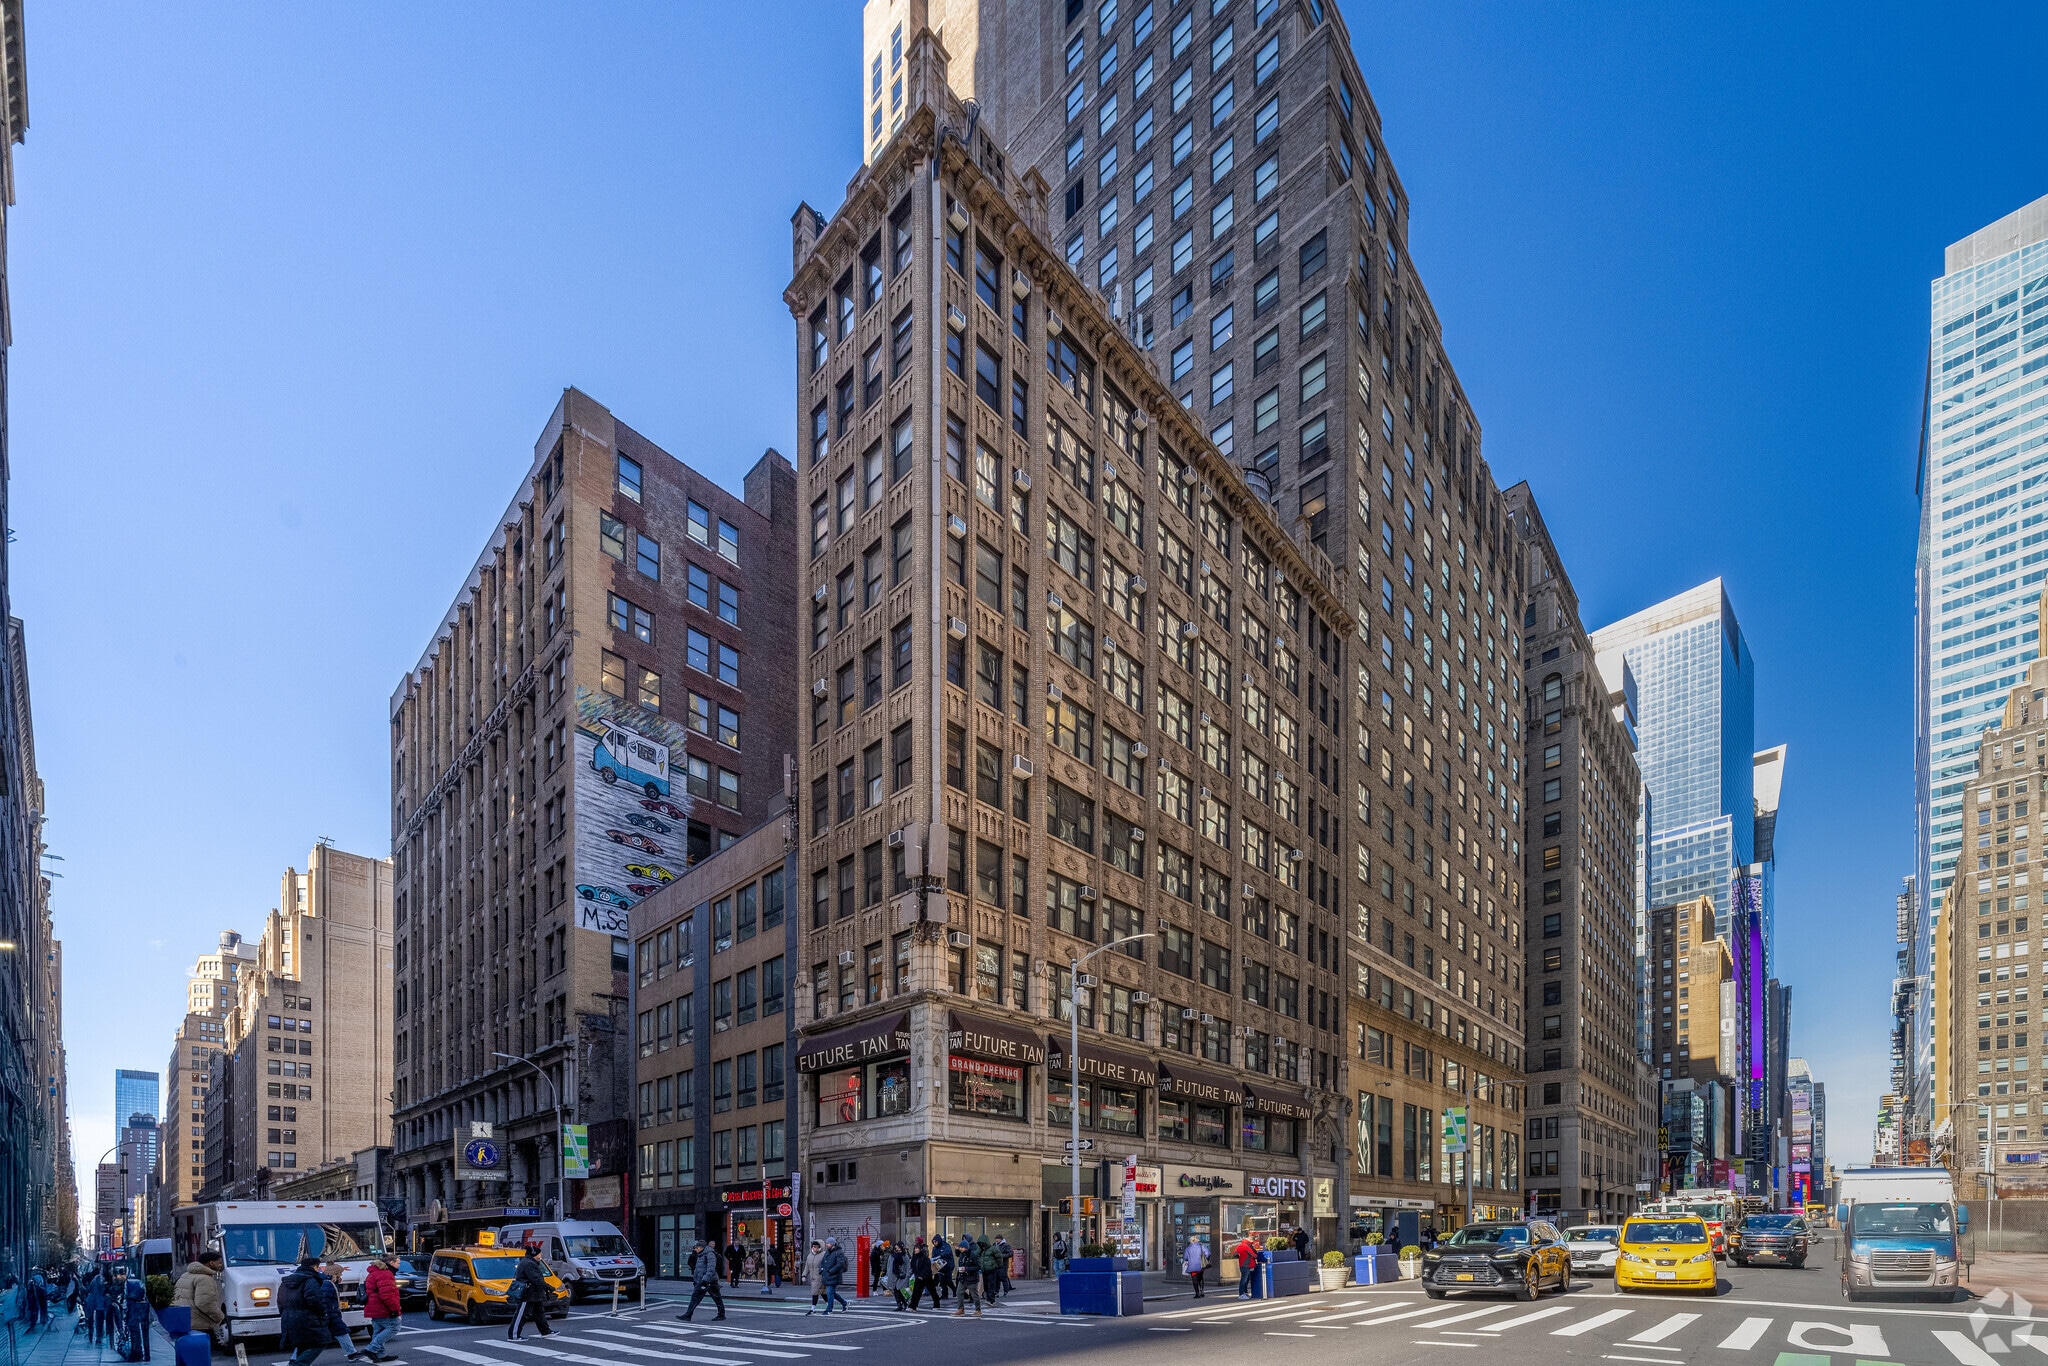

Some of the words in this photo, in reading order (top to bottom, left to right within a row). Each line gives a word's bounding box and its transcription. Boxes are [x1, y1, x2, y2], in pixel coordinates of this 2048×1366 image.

[1720, 1018, 1735, 1037] 9
[800, 1043, 854, 1071] FUTURE
[860, 1034, 888, 1056] TAN
[896, 1038, 911, 1049] TAN
[949, 1037, 963, 1049] TAN
[965, 1031, 1016, 1057] FUTURE
[1022, 1044, 1044, 1063] TAN
[951, 1058, 980, 1072] GRAND
[983, 1064, 1018, 1078] OPENING
[1049, 1059, 1061, 1069] TAN
[1068, 1054, 1125, 1080] FUTURE
[1131, 1068, 1155, 1086] TAN
[1176, 1079, 1219, 1100] FUTURE
[1224, 1089, 1242, 1104] TAN
[1245, 1100, 1254, 1108] AN
[1258, 1098, 1292, 1116] FUTURE
[1296, 1106, 1311, 1119] TAN
[743, 1188, 770, 1200] DELICATESEN
[1266, 1177, 1306, 1198] GIFTS
[507, 1197, 538, 1207] CAFE
[589, 1259, 634, 1268] FedEx
